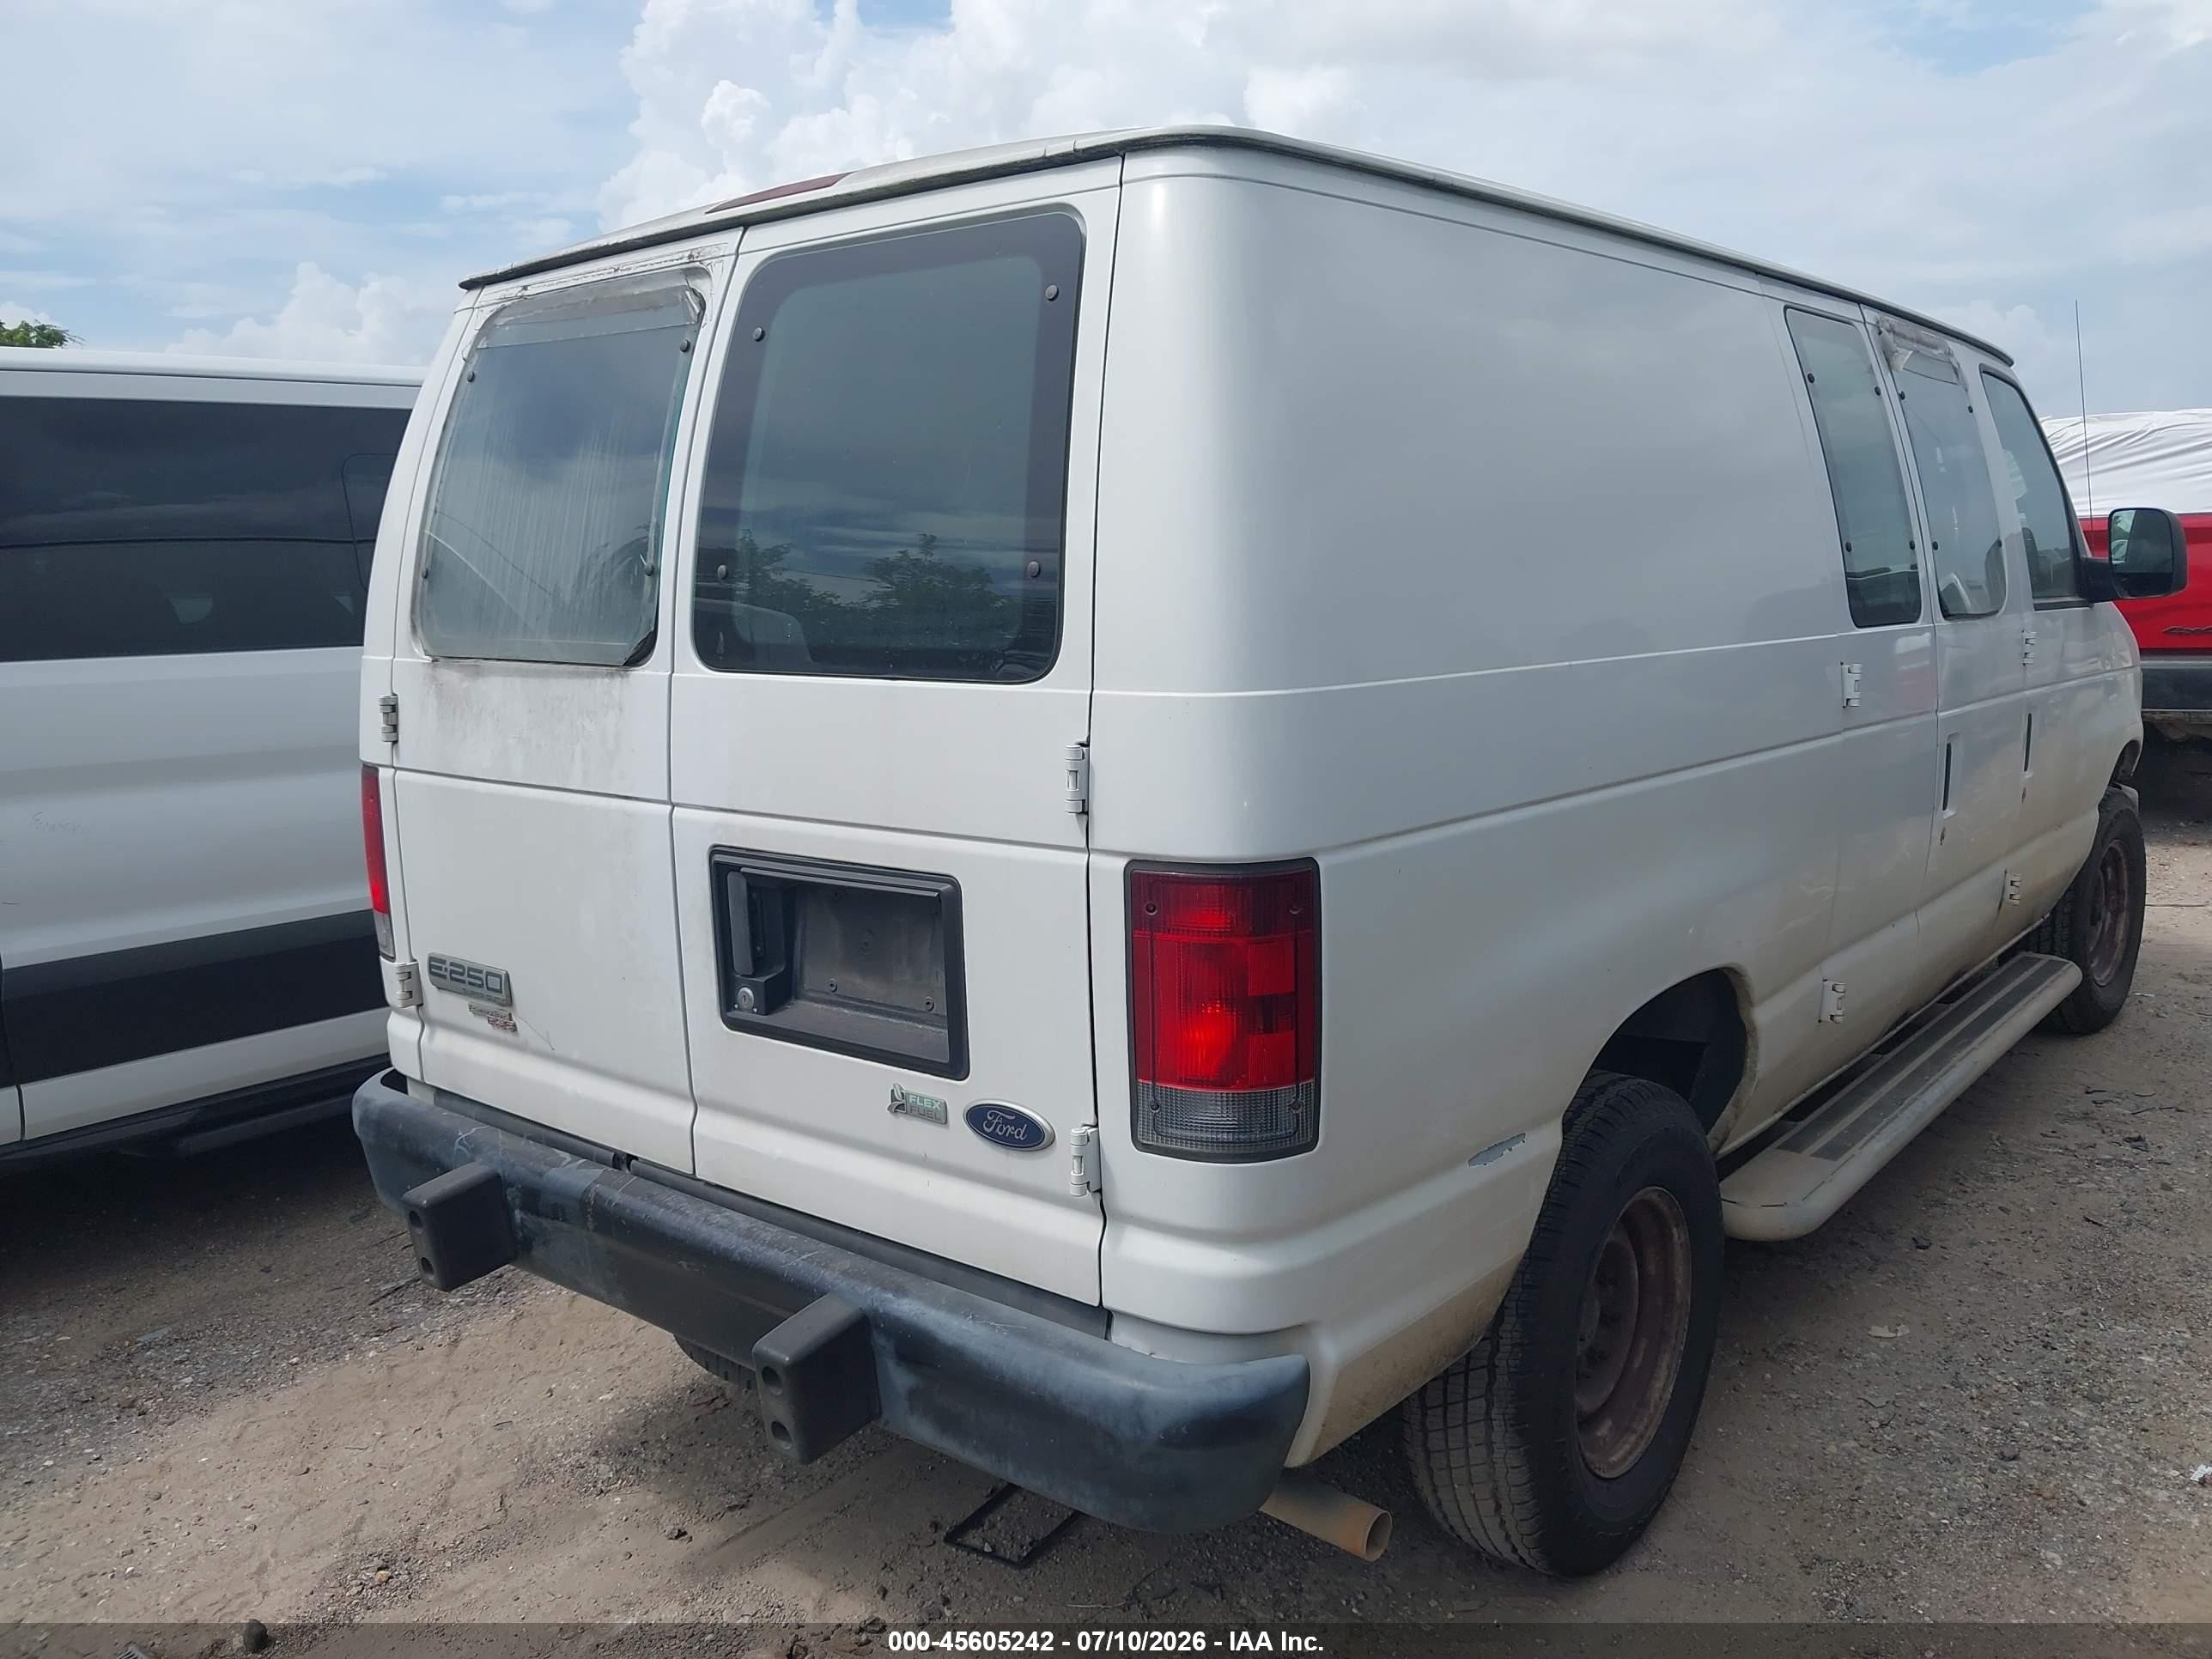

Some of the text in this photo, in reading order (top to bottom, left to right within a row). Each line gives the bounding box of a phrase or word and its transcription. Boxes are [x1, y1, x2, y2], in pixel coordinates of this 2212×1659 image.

[908, 1094, 942, 1111] FLEX
[909, 1105, 944, 1121] FUEL
[982, 1109, 1029, 1141] Ford
